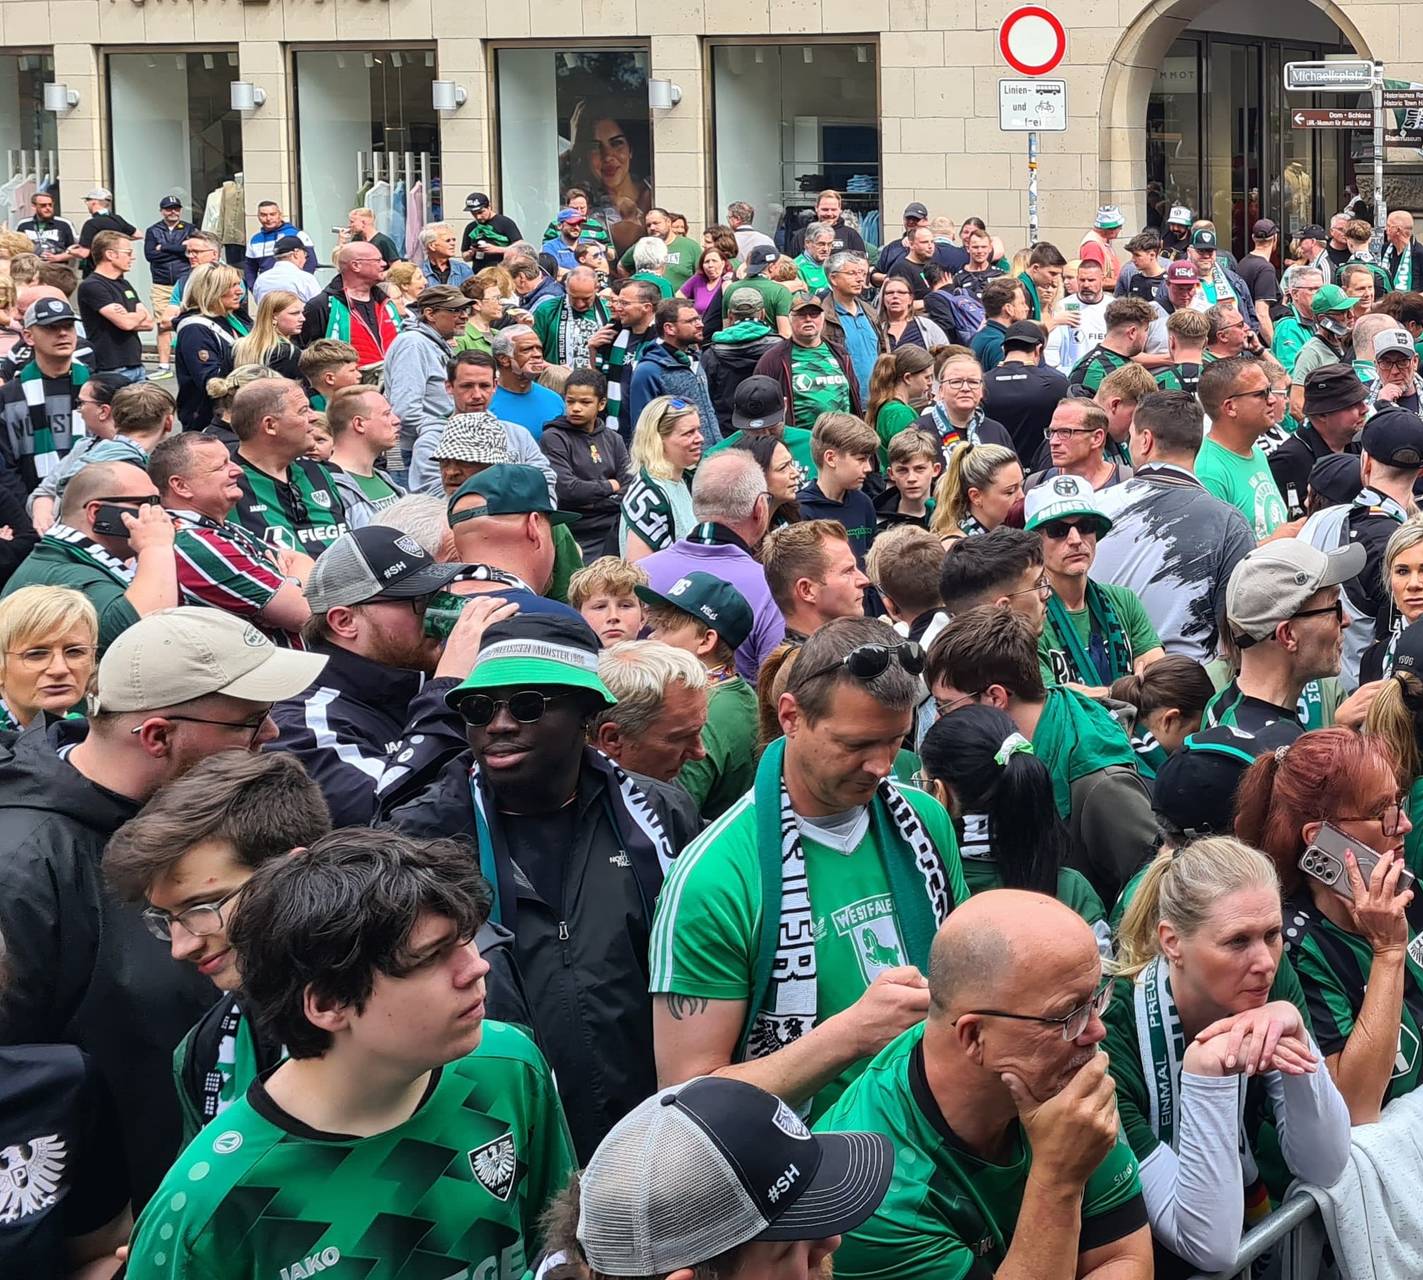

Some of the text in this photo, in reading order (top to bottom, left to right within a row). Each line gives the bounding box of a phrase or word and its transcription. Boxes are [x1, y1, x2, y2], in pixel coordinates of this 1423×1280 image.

[1292, 69, 1366, 83] Michaelisplatz
[1004, 85, 1032, 95] Linien-
[1012, 102, 1027, 112] und
[384, 561, 407, 580] #SH
[836, 898, 893, 926] WESTFALE
[1159, 1053, 1174, 1125] EINMAL
[766, 1163, 801, 1204] #SH
[279, 1245, 339, 1280] JAKO
